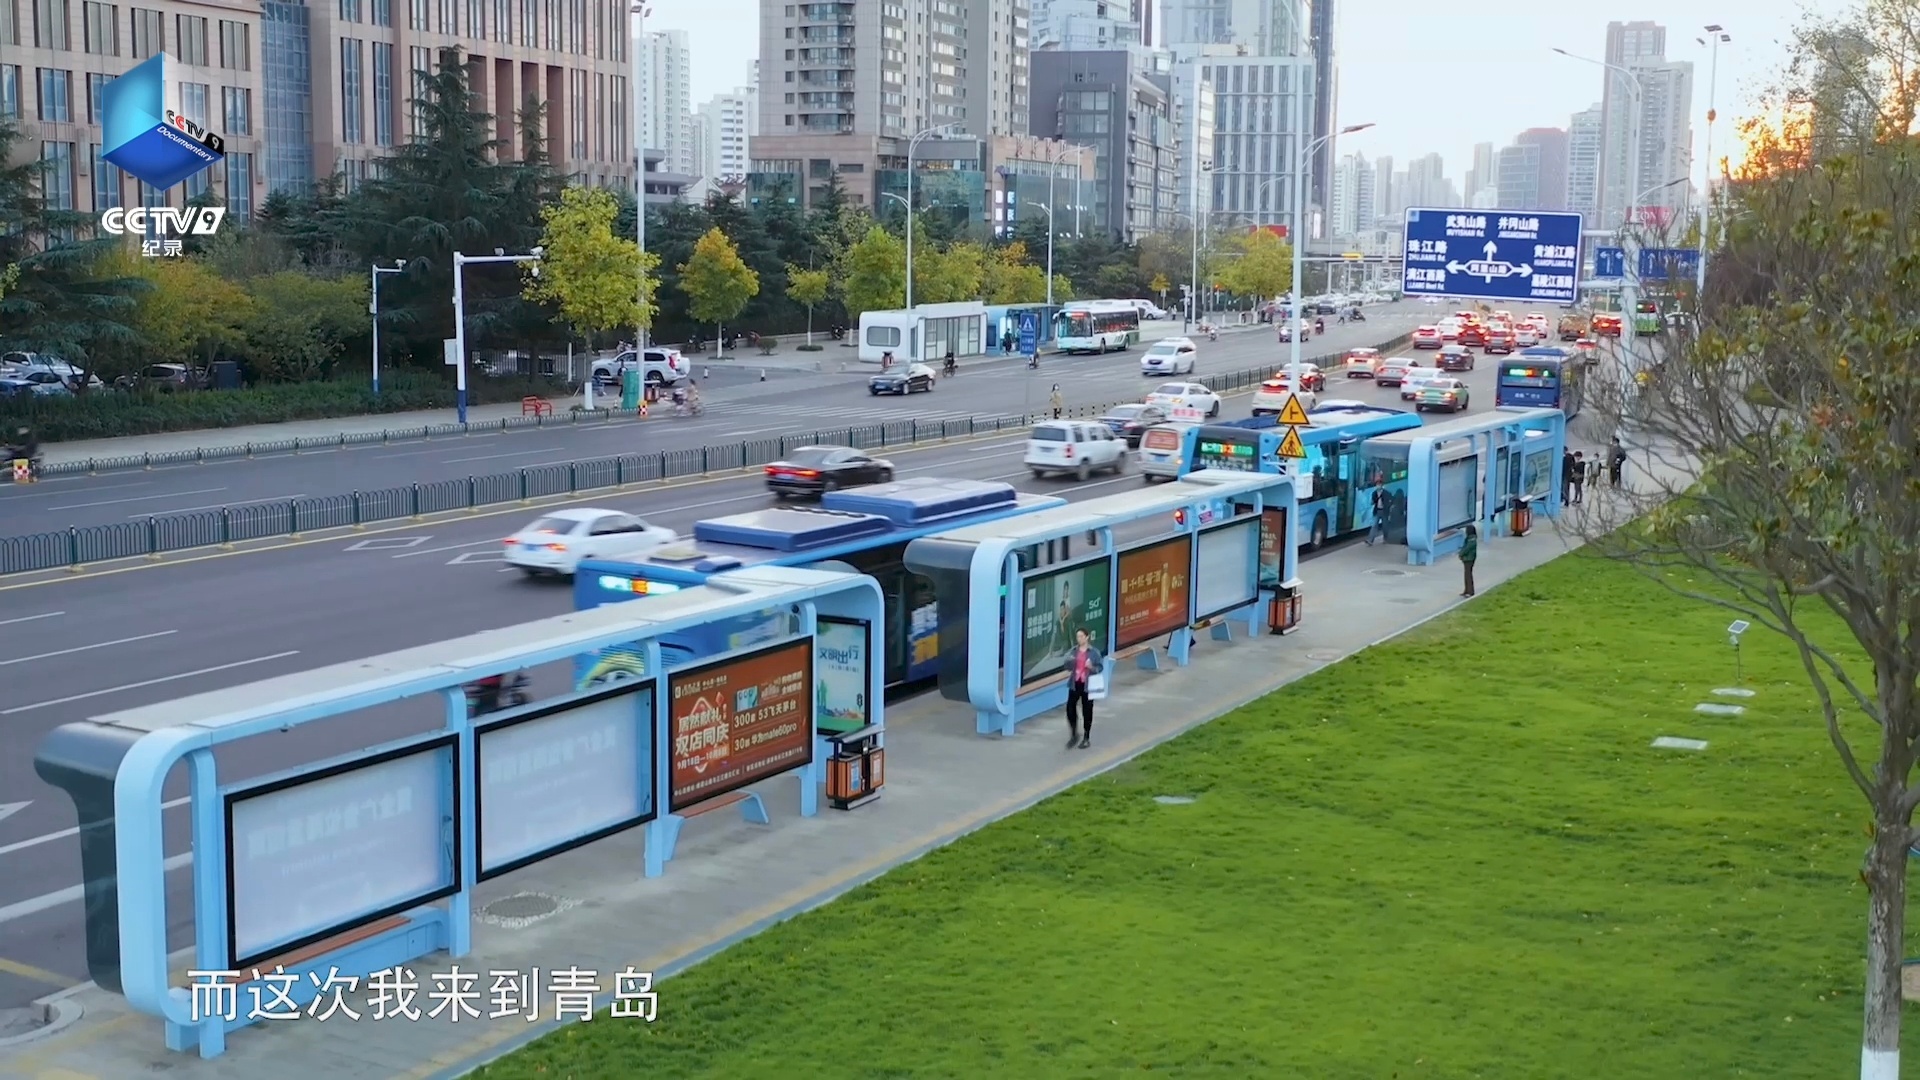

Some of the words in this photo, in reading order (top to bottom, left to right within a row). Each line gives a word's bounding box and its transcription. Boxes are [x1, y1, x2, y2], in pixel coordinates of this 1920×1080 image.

[1446, 214, 1487, 229] 武夷山路
[1498, 216, 1539, 231] 井冈山路
[1408, 239, 1448, 254] 珠江路
[1534, 244, 1576, 259] 黄浦江路
[676, 723, 729, 757] 双店同庆
